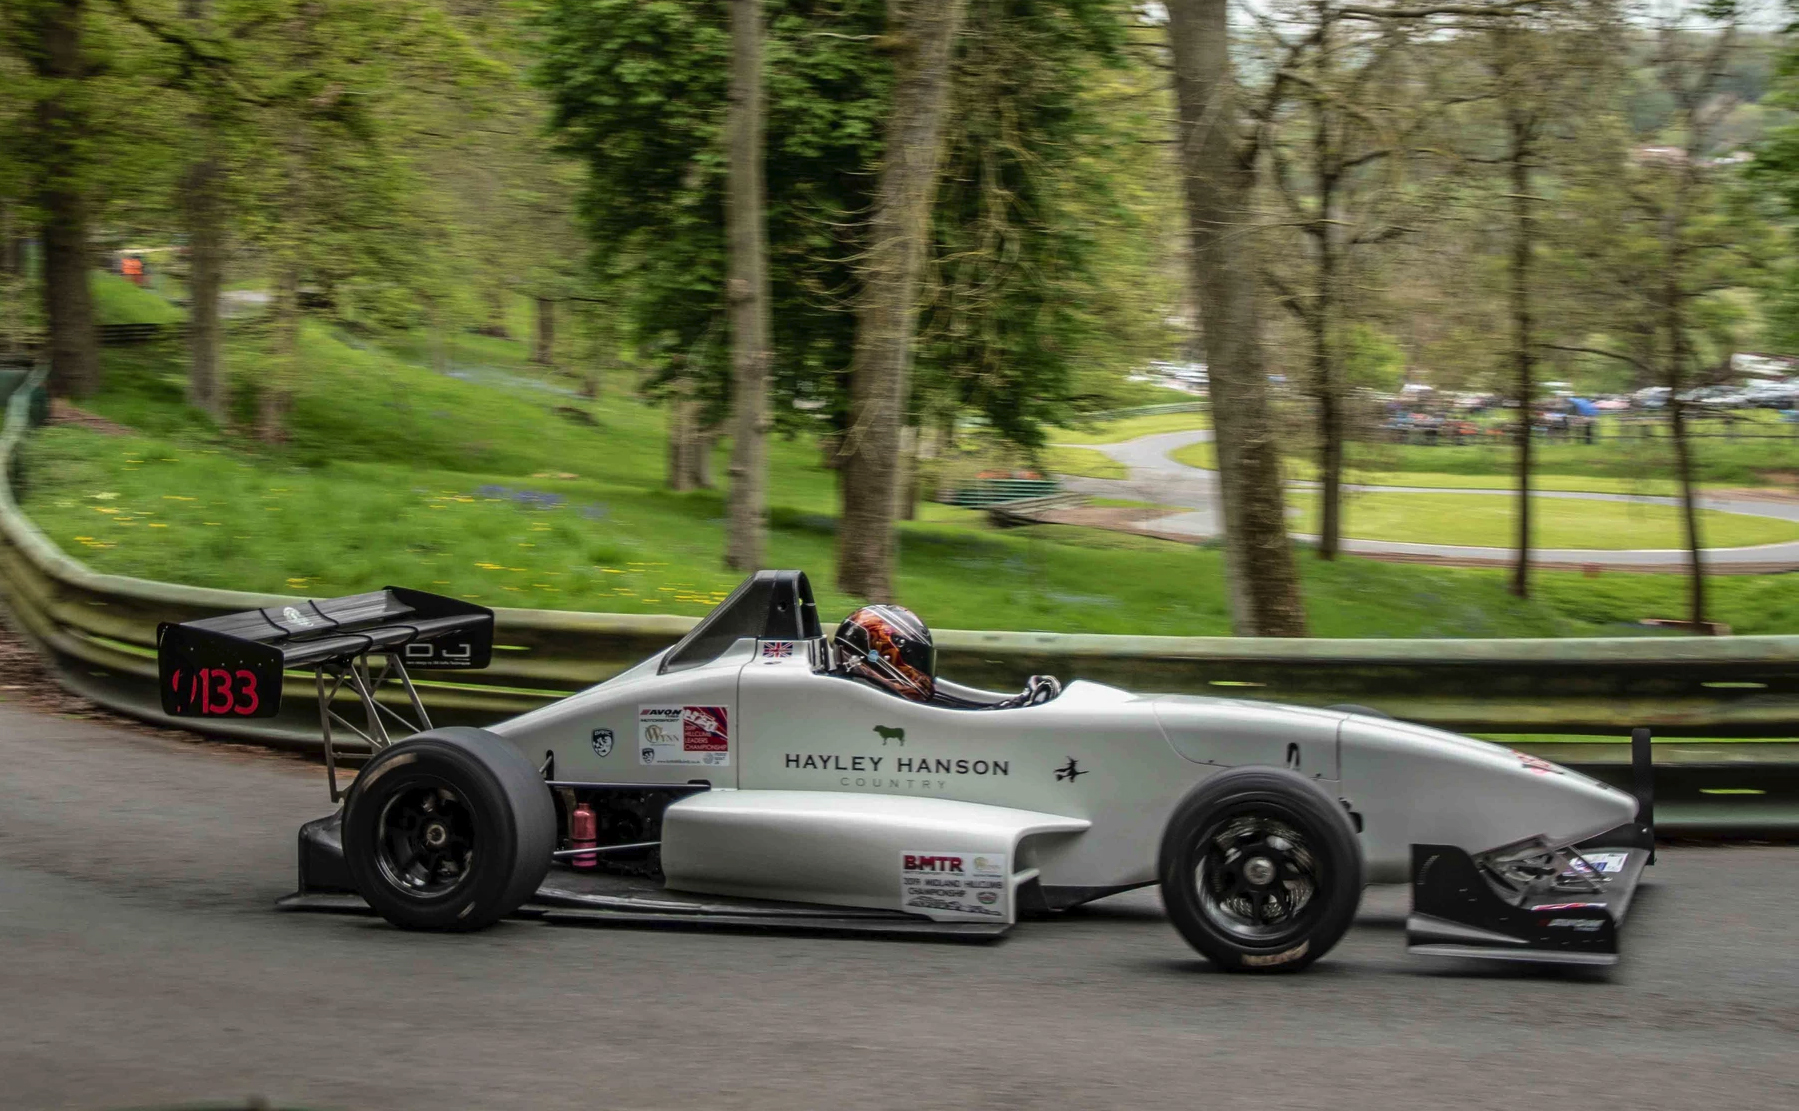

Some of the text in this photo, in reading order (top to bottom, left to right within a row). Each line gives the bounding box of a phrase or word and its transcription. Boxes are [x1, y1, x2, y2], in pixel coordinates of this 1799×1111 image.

[785, 754, 1009, 776] HAYLEY HANSON
[840, 777, 945, 790] COUNTRY
[903, 855, 964, 872] BMTR
